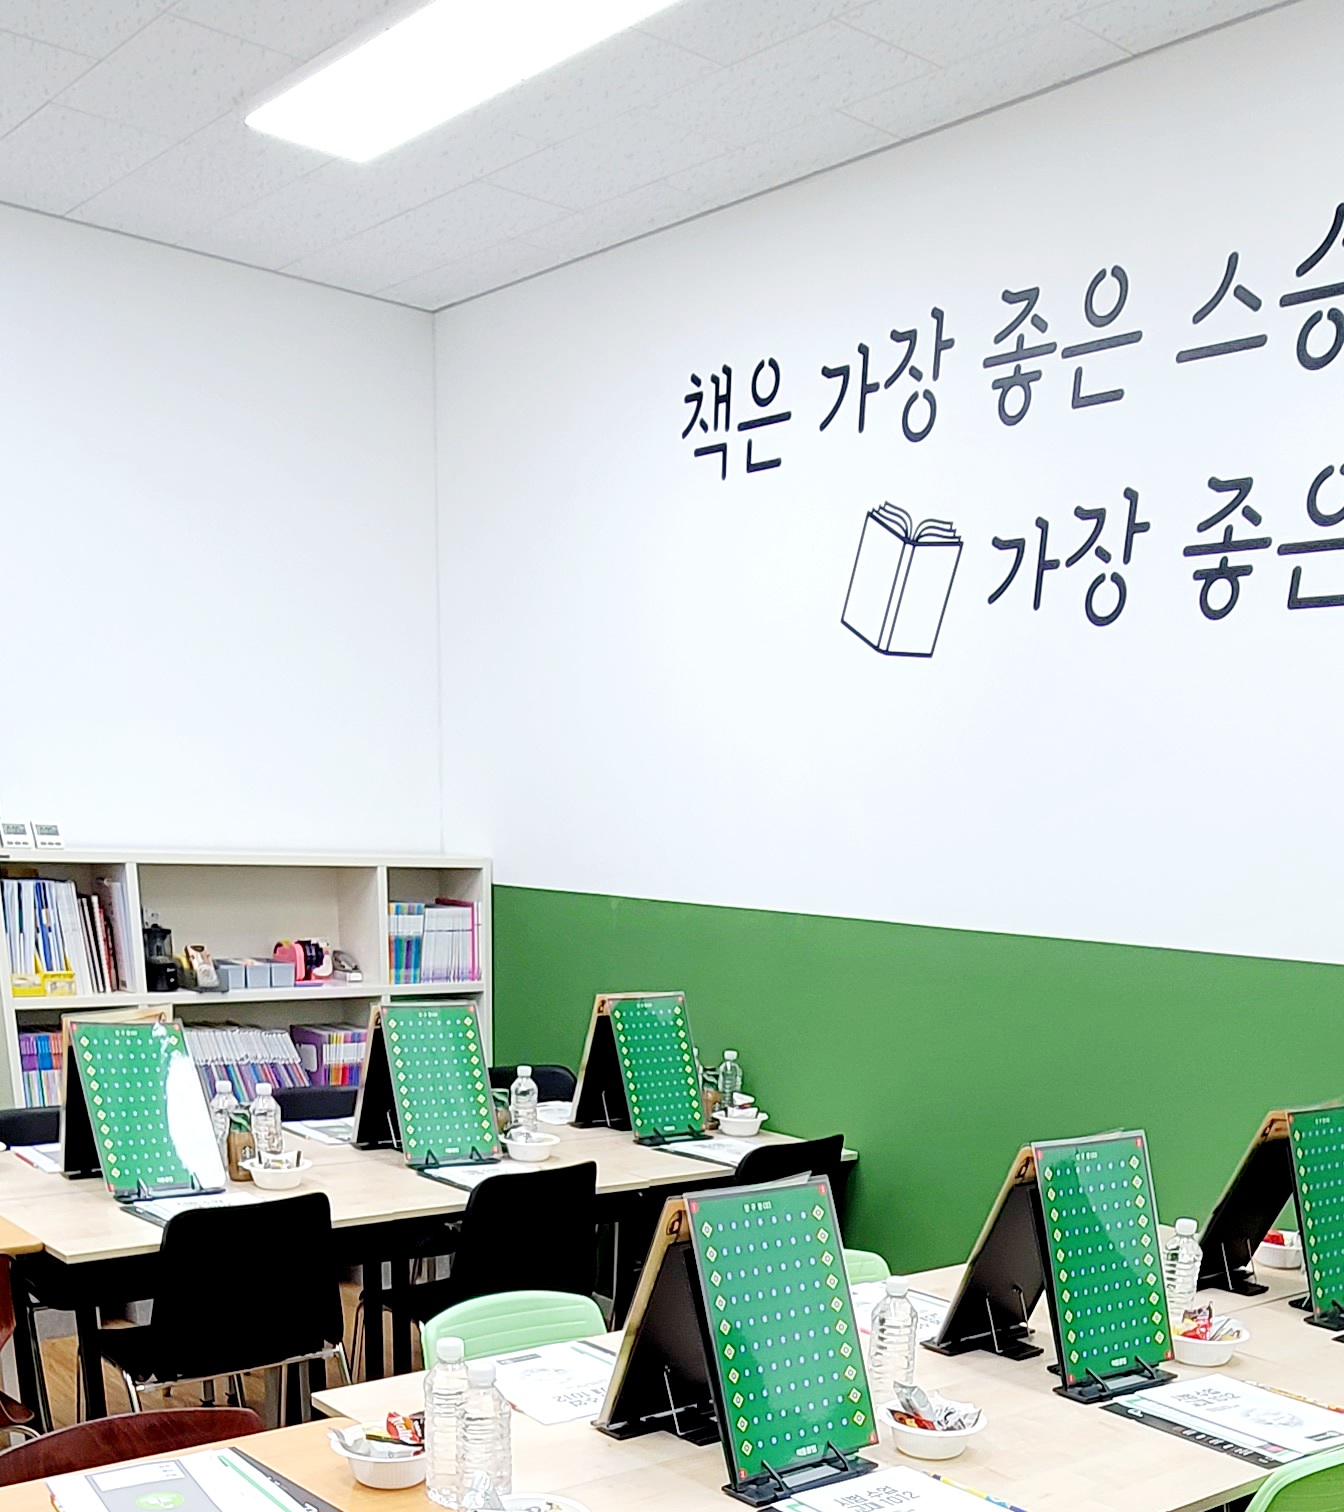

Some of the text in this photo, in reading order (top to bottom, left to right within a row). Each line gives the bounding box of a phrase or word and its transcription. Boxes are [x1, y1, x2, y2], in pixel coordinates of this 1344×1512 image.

[682, 358, 791, 480] 책은
[820, 307, 954, 442] 가장
[983, 266, 1142, 426] 좋은
[988, 487, 1150, 626] 가장
[829, 1485, 900, 1507] 시범 수업
[877, 1490, 921, 1506] 1012
